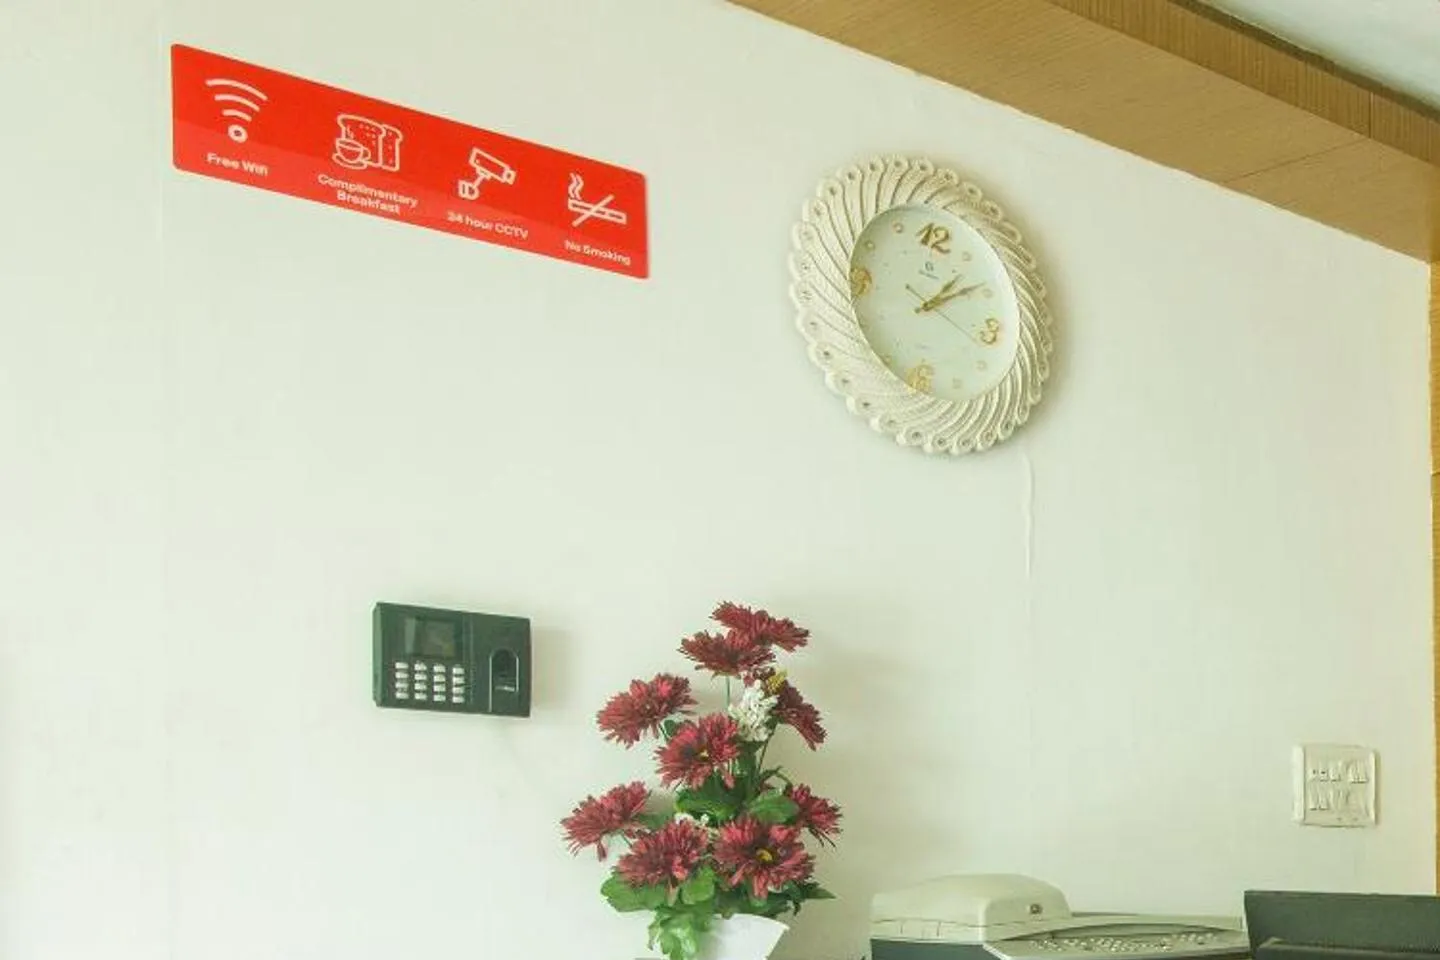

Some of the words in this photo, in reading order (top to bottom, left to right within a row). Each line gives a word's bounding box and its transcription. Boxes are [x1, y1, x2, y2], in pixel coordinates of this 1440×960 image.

[206, 152, 240, 170] Free
[316, 173, 419, 208] Complimentary
[336, 190, 401, 215] Breakfast
[447, 211, 464, 224] 24
[465, 215, 493, 231] hour
[494, 222, 529, 240] CCTV
[916, 222, 952, 255] 12
[564, 239, 581, 253] No
[582, 244, 632, 266] Smoking
[979, 317, 1001, 346] 3
